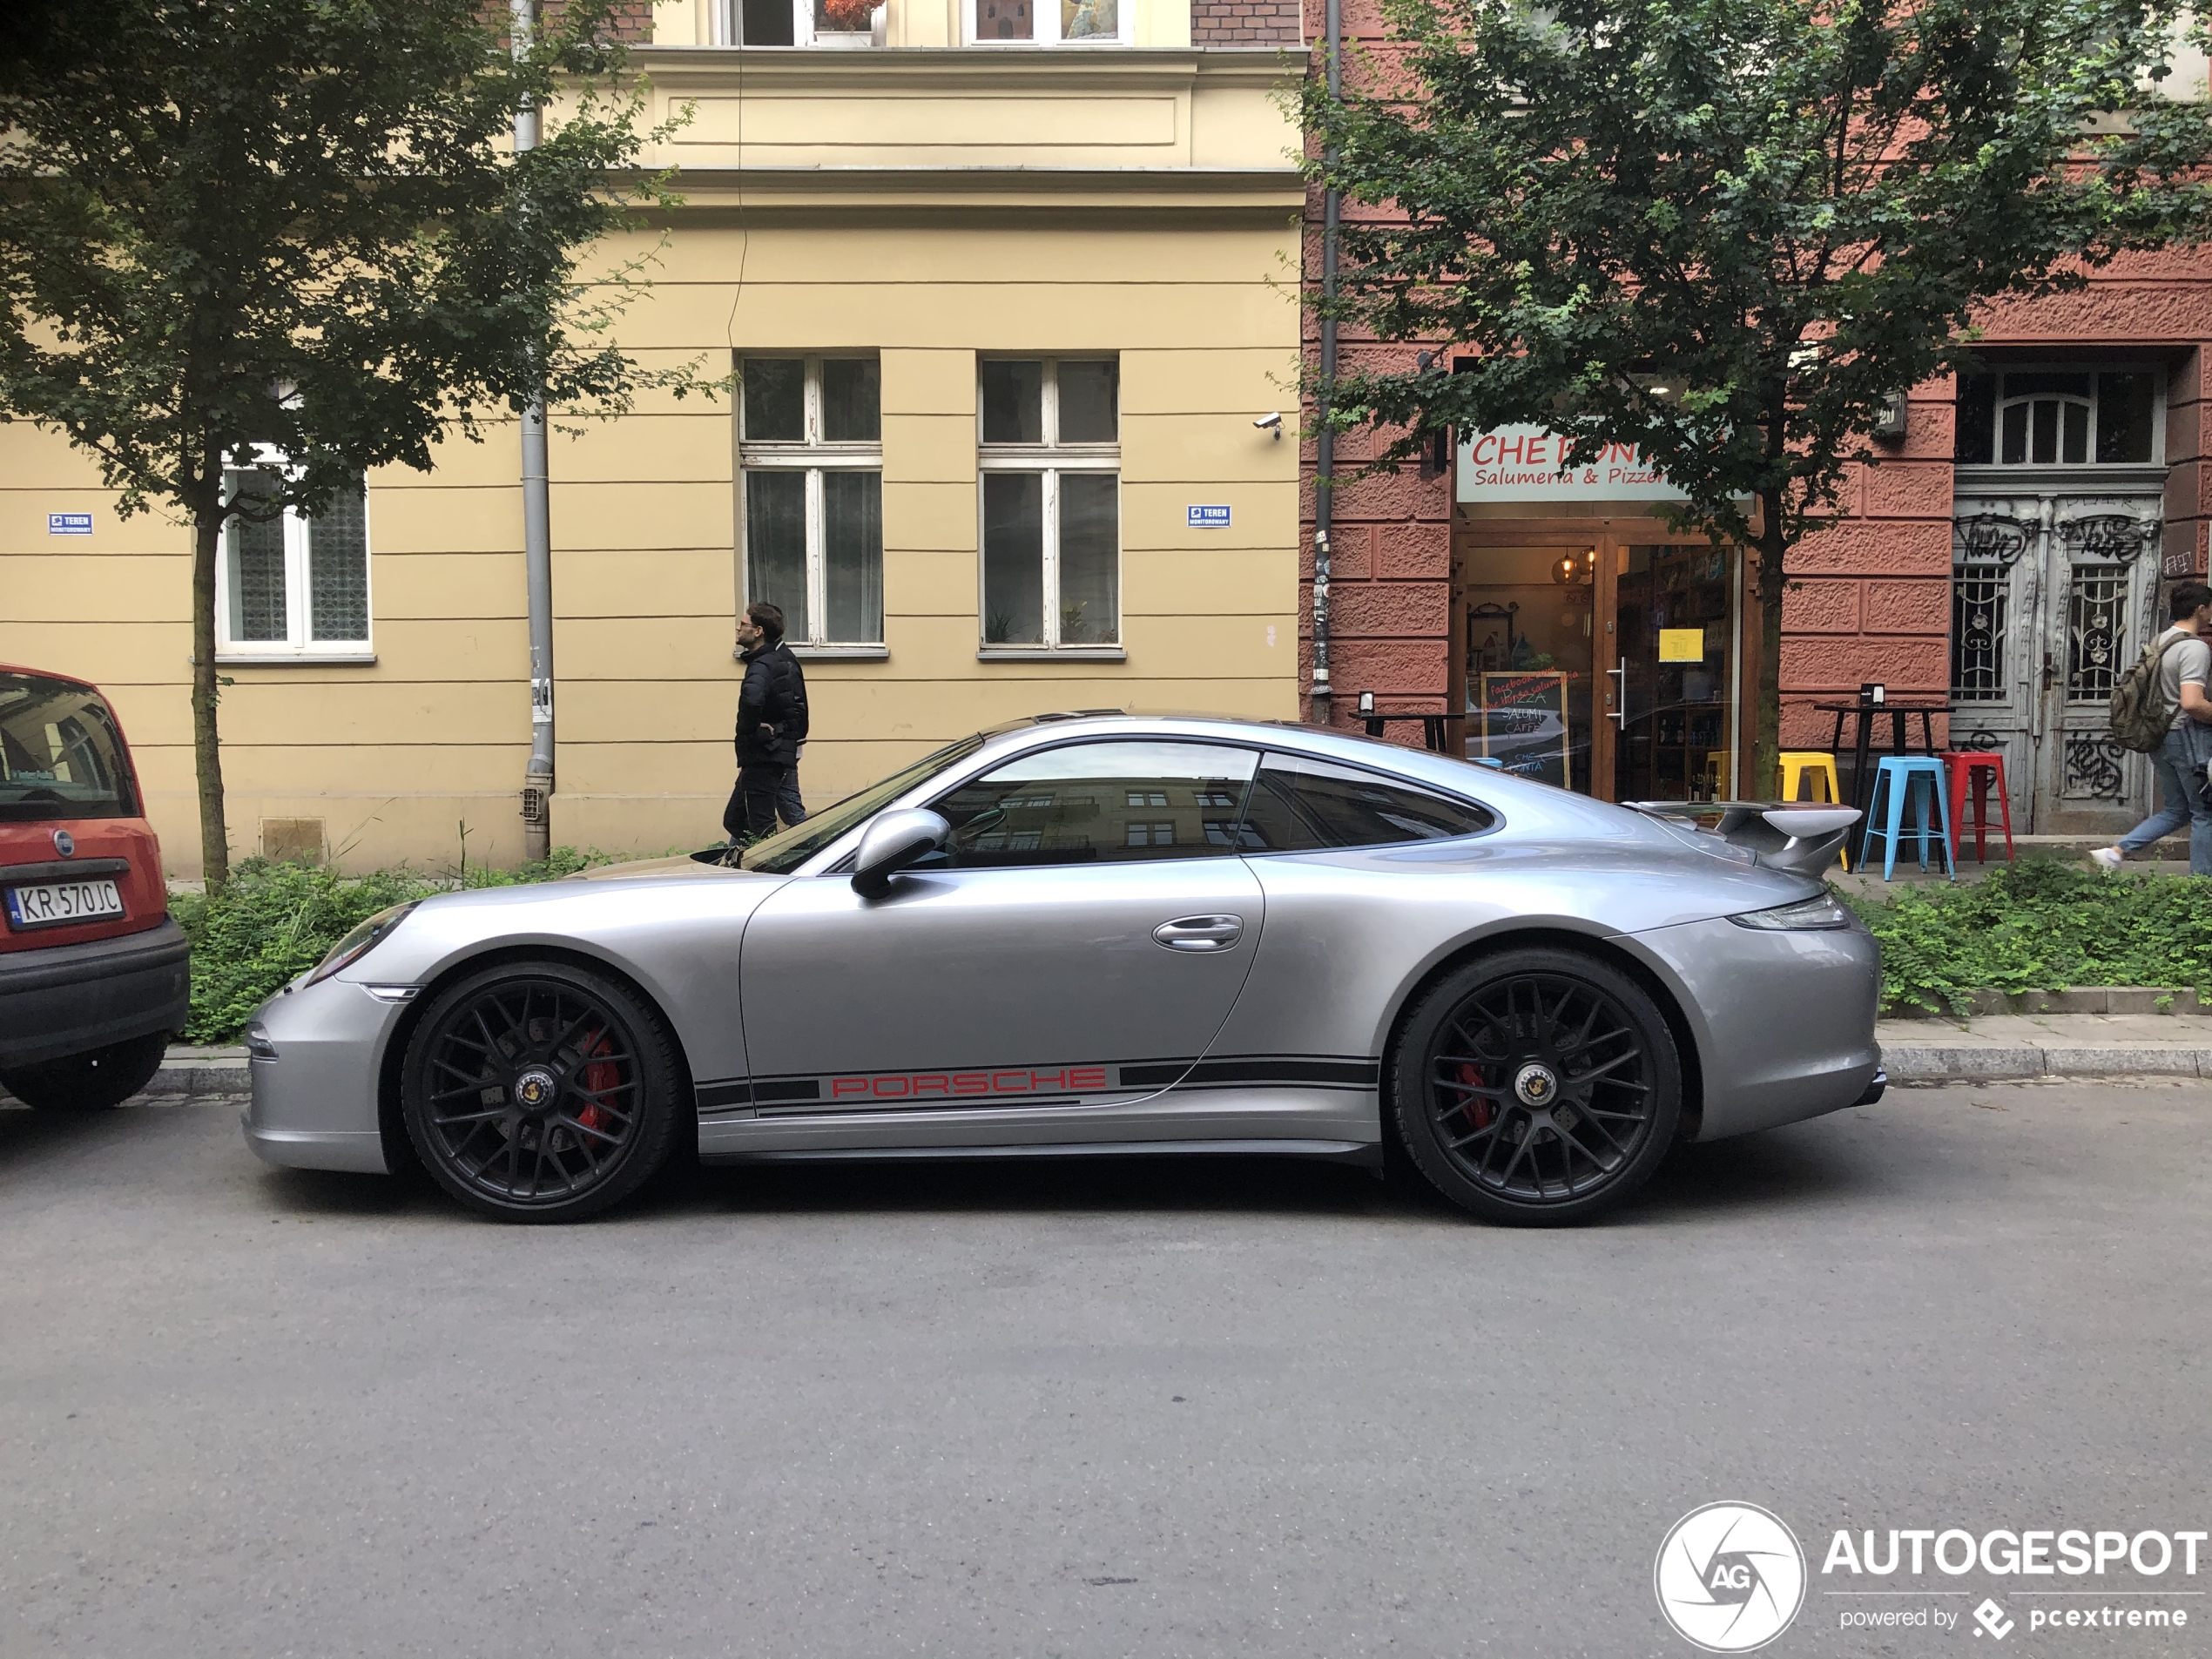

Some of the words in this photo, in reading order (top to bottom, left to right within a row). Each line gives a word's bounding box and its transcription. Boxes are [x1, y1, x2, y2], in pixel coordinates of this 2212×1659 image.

[1878, 408, 1895, 425] 20
[1472, 435, 1548, 465] CHE
[1583, 468, 1599, 484] &
[1608, 467, 1669, 485] Pizzer
[64, 516, 90, 525] TEREN
[1203, 509, 1228, 517] TEREN
[832, 1068, 1106, 1098] PORSCHE
